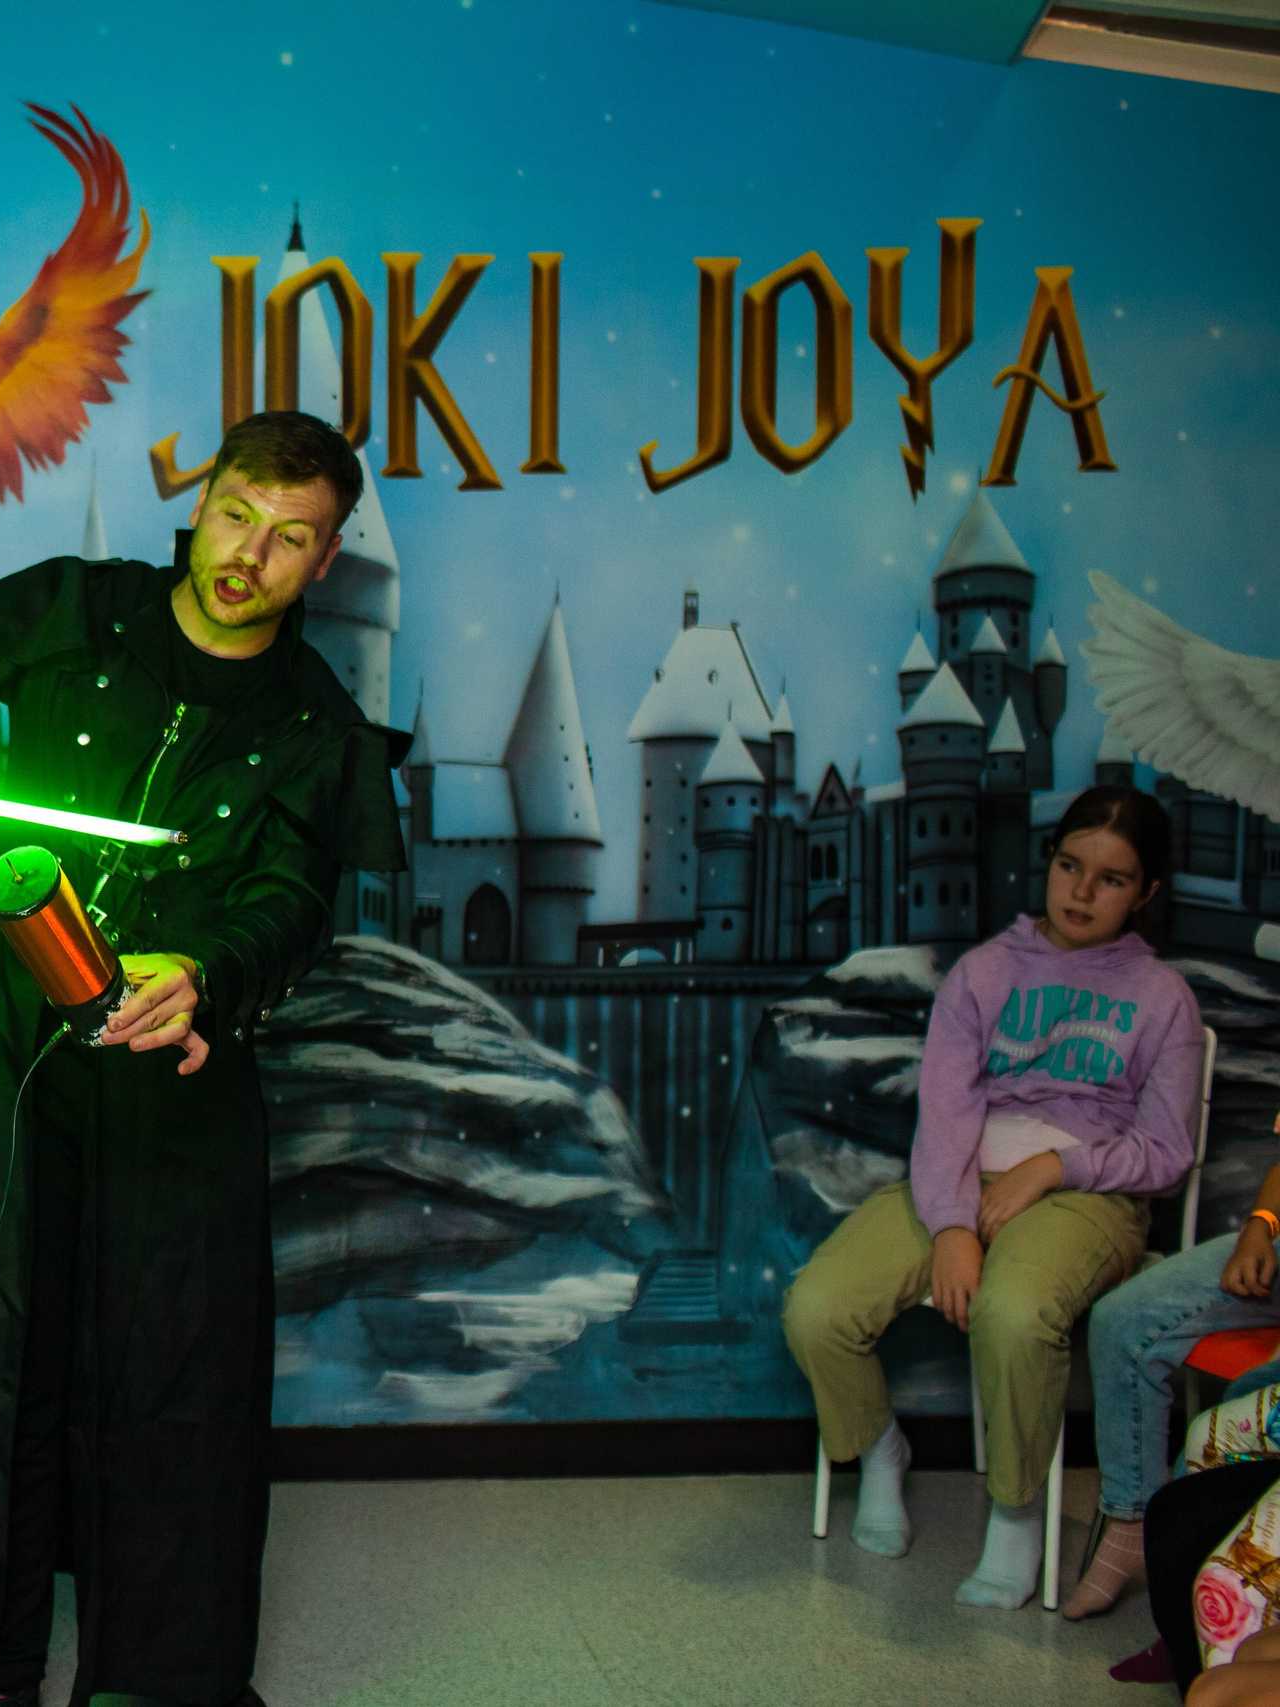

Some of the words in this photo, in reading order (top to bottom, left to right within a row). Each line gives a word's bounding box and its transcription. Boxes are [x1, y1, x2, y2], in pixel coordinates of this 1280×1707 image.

[149, 252, 567, 501] JOKI
[639, 217, 1118, 506] JOYA
[997, 984, 1138, 1043] ALWAYS
